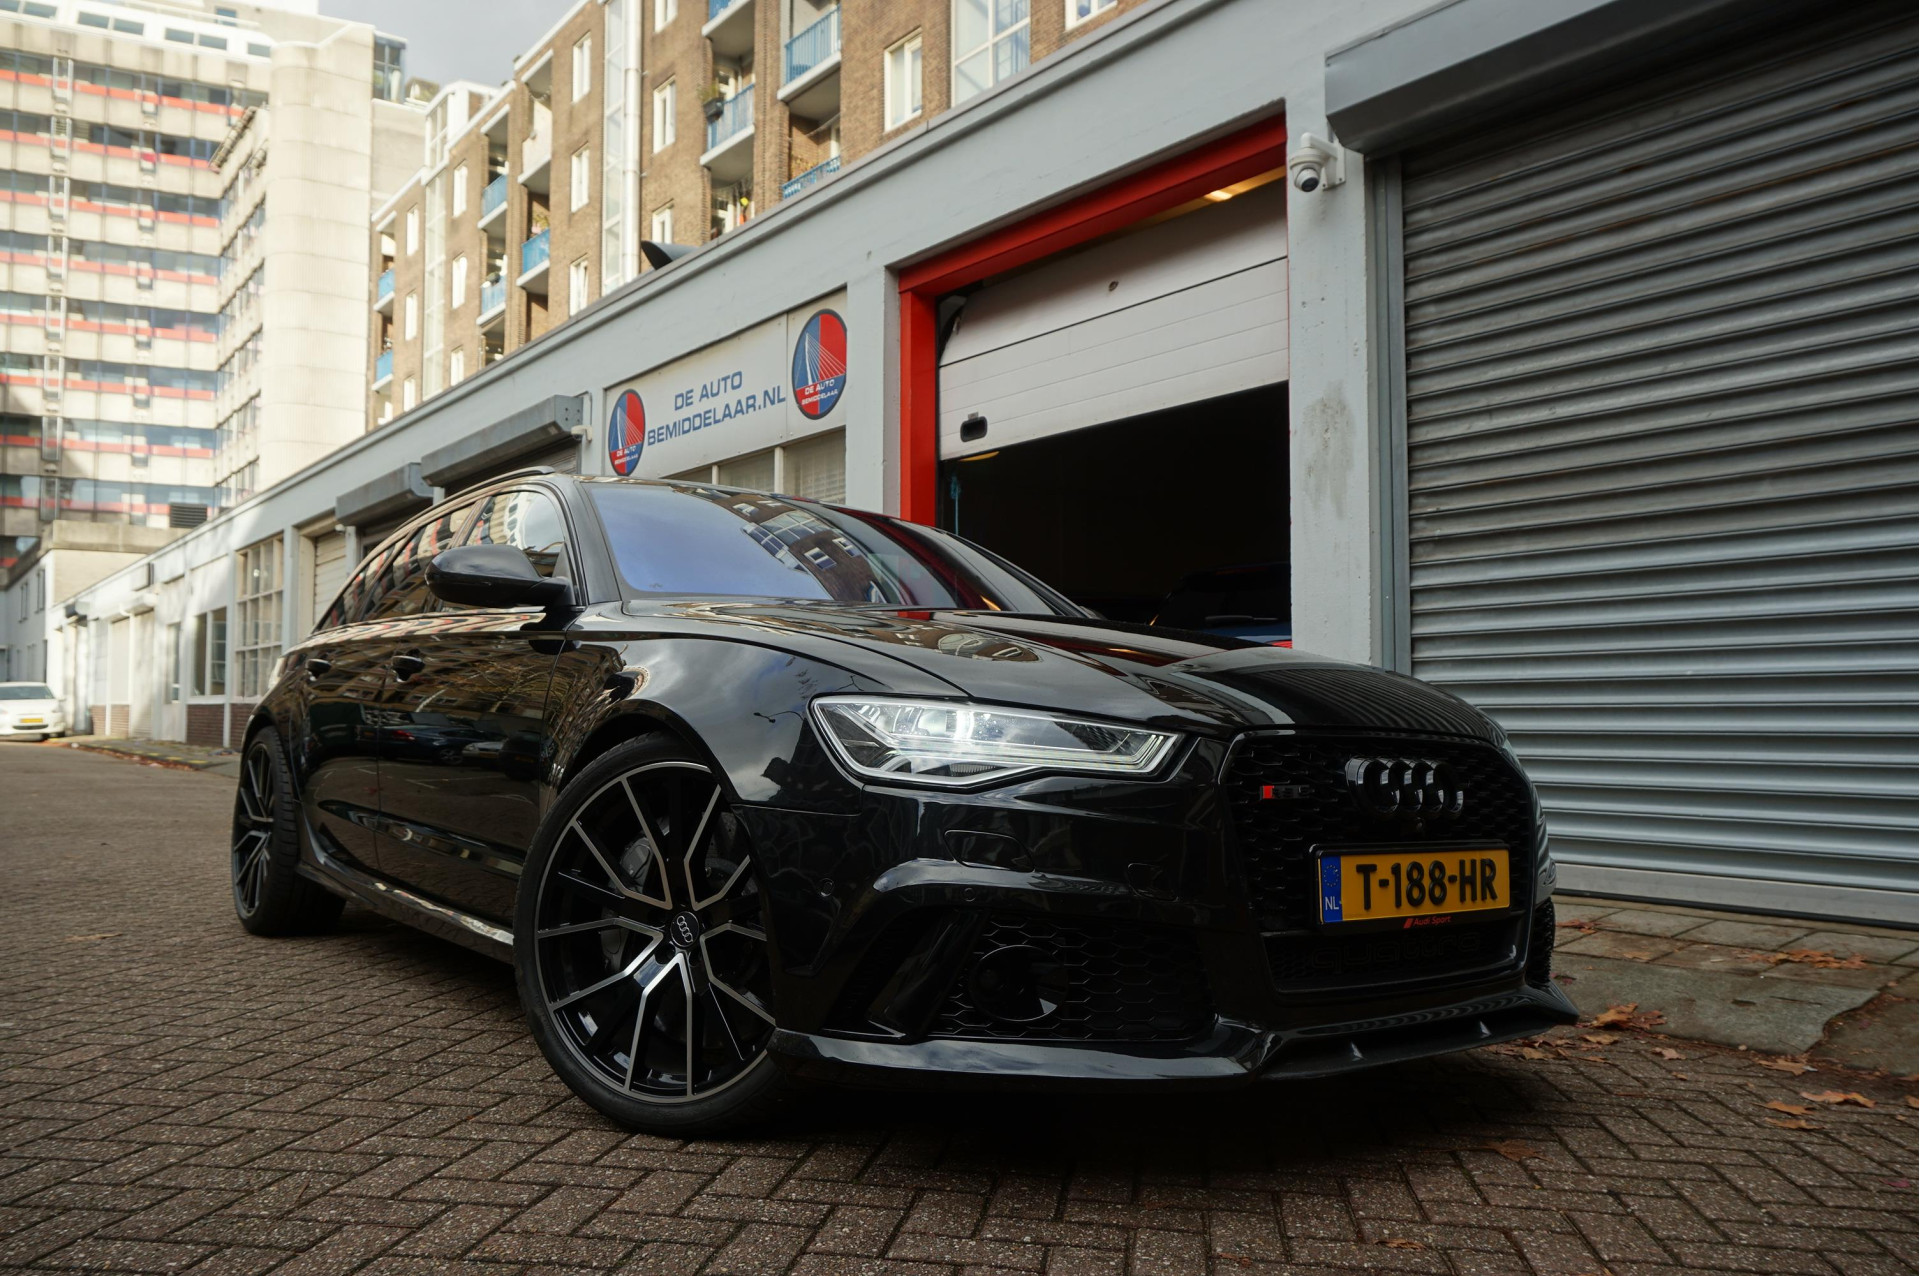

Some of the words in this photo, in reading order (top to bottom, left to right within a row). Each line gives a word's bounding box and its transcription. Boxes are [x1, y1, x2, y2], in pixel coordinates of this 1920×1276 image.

[674, 388, 694, 411] DE
[699, 370, 743, 402] AUTO
[804, 385, 815, 395] DE
[816, 379, 835, 391] AUTO
[647, 385, 786, 446] BEMIDDELAAR.NL
[1355, 858, 1498, 912] T-188-HR
[1324, 896, 1340, 911] NL
[1413, 917, 1430, 926] Audi
[1431, 915, 1451, 926] Sport
